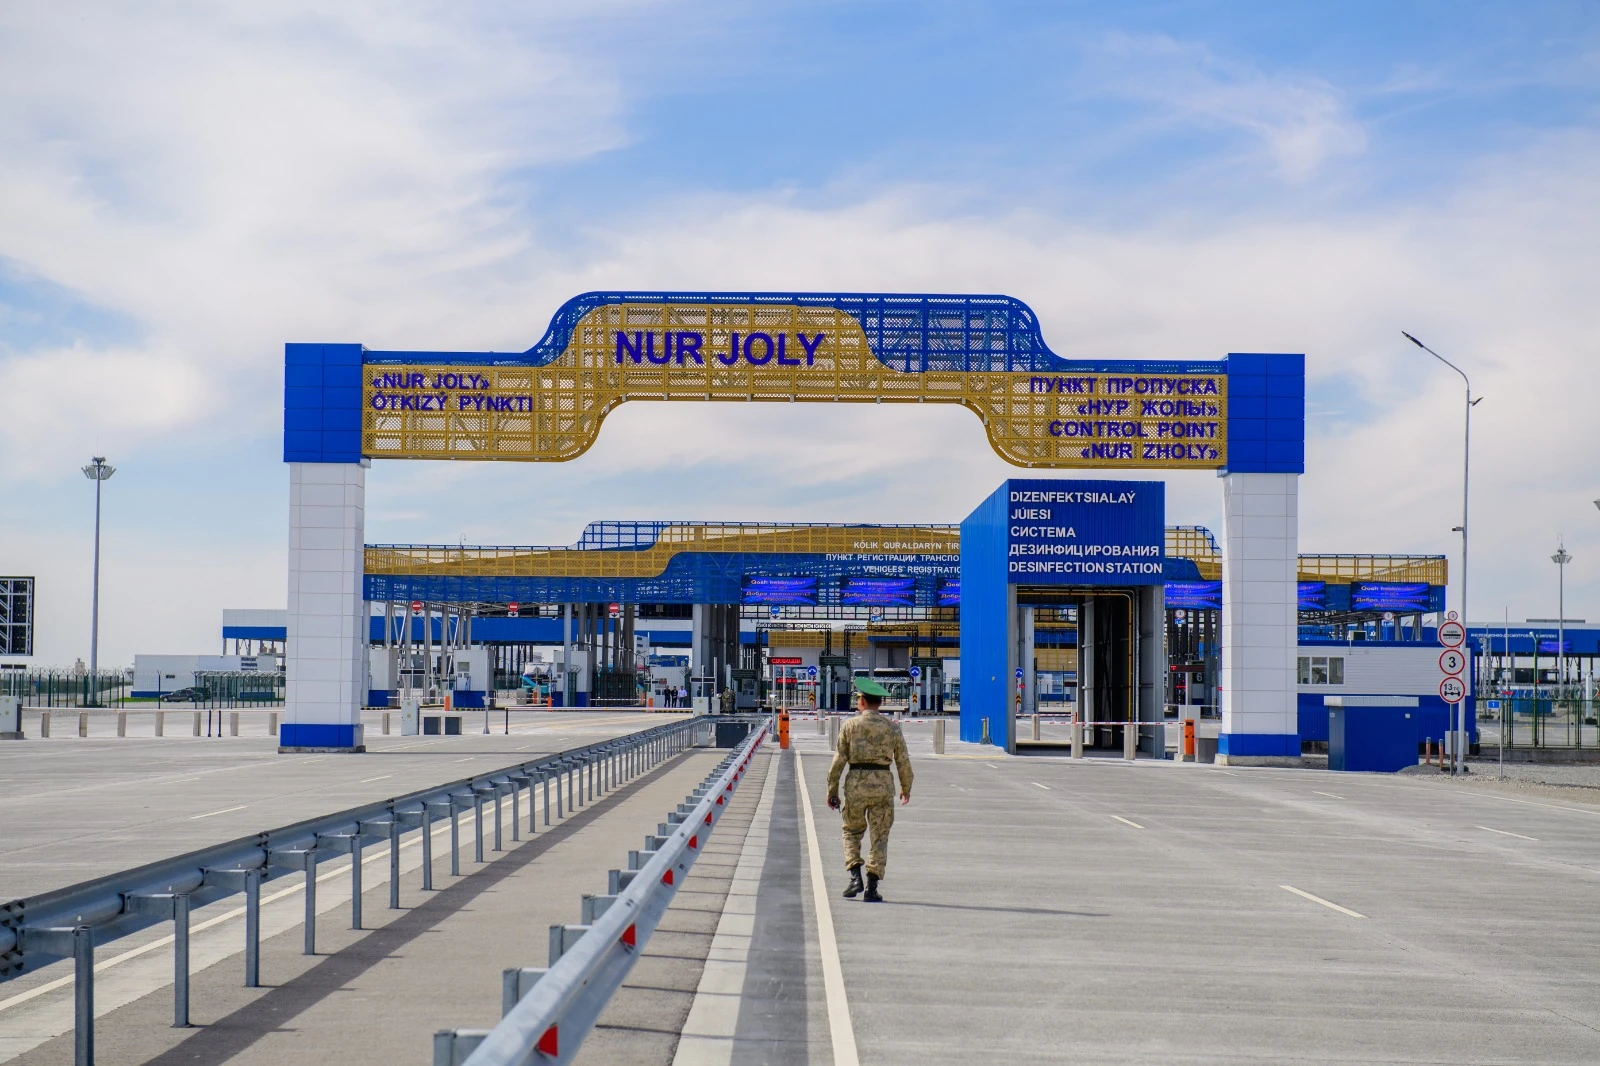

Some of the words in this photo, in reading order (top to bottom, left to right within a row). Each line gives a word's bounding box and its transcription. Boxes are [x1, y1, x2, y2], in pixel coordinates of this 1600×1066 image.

[616, 332, 704, 365] NUR
[718, 332, 824, 366] JOLY
[372, 373, 424, 388] «NUR
[432, 374, 490, 390] JOLY»
[1030, 377, 1097, 393] ПУНКТ
[1107, 378, 1218, 394] ПРОПУСКА
[1077, 400, 1128, 415] «НУР
[1140, 400, 1218, 416] ЖОЛЫ»
[1048, 421, 1148, 437] CONTROL
[1158, 422, 1218, 438] POINT
[1081, 443, 1132, 459] «NUR
[1142, 443, 1218, 460] ZHOLY»
[1010, 490, 1136, 504] DIZENFEKTSIIALAÝ
[1011, 507, 1050, 520] JÚIESI
[1010, 526, 1076, 538] СИСТЕМА
[854, 540, 878, 548] KÓLIK
[1009, 544, 1160, 557] ДЕЗИНФИЦИРОВАНИЯ
[858, 554, 916, 562] РЕГИСТРАЦИИ
[1448, 657, 1456, 668] 3
[1196, 673, 1202, 682] 6
